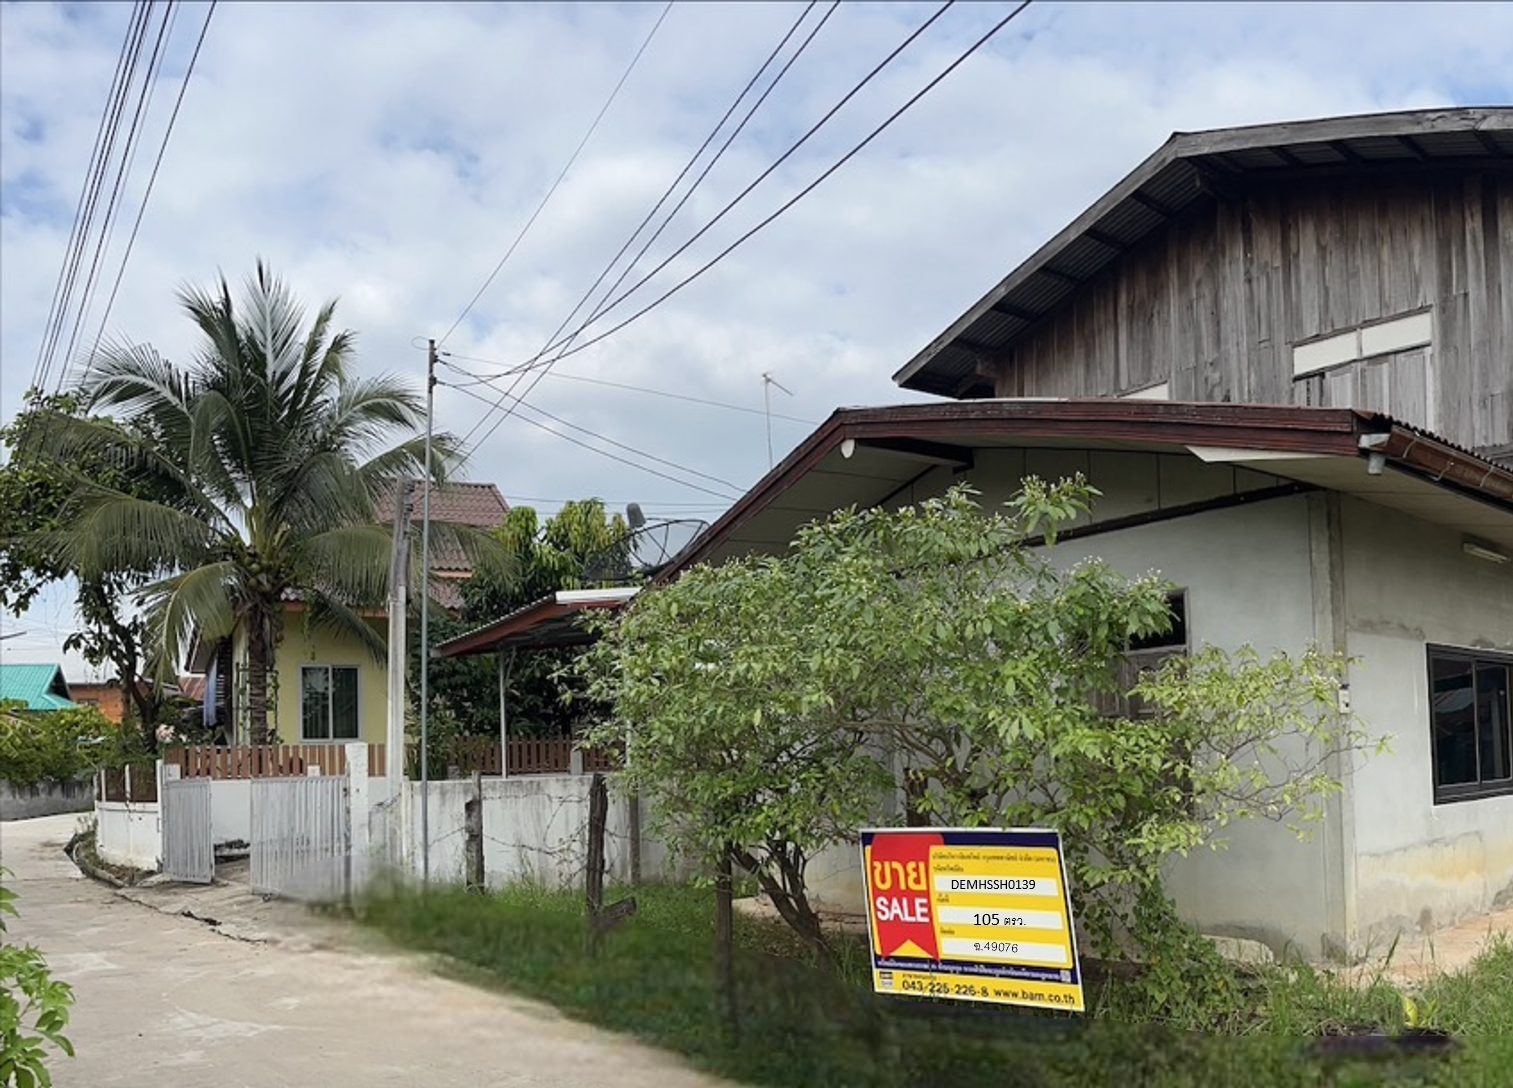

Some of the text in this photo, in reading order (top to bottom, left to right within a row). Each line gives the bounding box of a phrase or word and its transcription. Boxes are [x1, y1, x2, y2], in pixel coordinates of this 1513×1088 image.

[873, 861, 927, 891] ขาย
[951, 879, 1036, 890] DEMHSSH0139
[876, 896, 930, 923] SALE
[973, 913, 1000, 926] 105
[993, 988, 1075, 1005] www.bam.co.th
